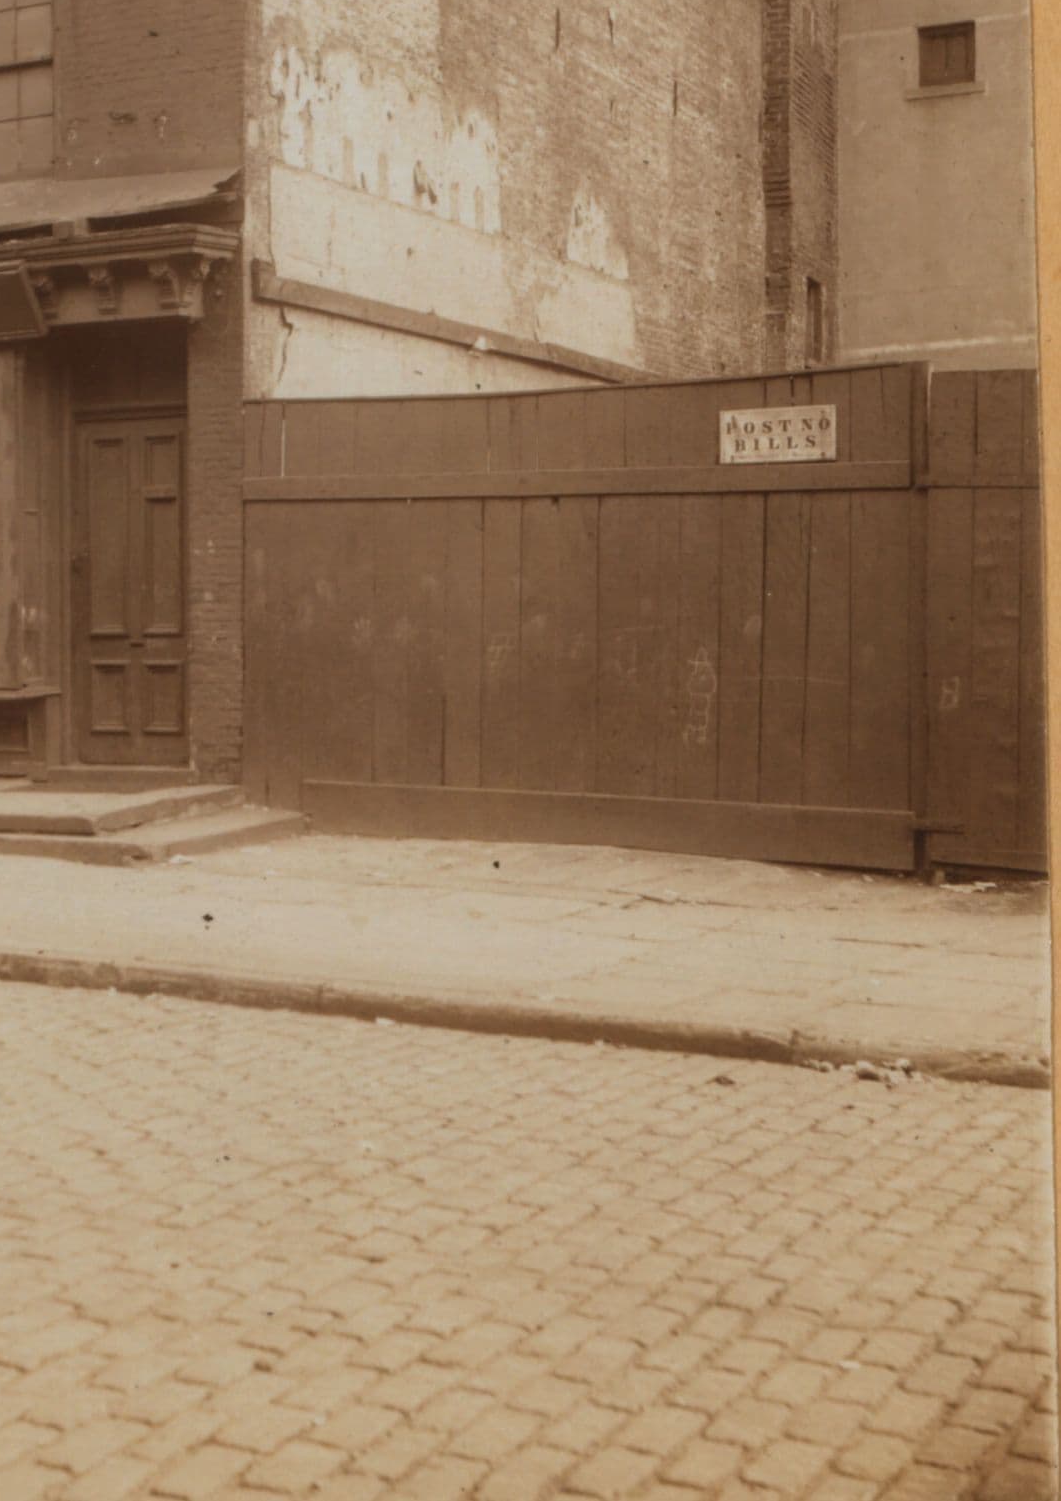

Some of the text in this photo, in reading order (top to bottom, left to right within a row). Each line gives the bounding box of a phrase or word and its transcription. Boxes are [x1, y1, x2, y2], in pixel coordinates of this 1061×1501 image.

[726, 417, 831, 435] POST NO
[735, 436, 817, 452] BILLS
